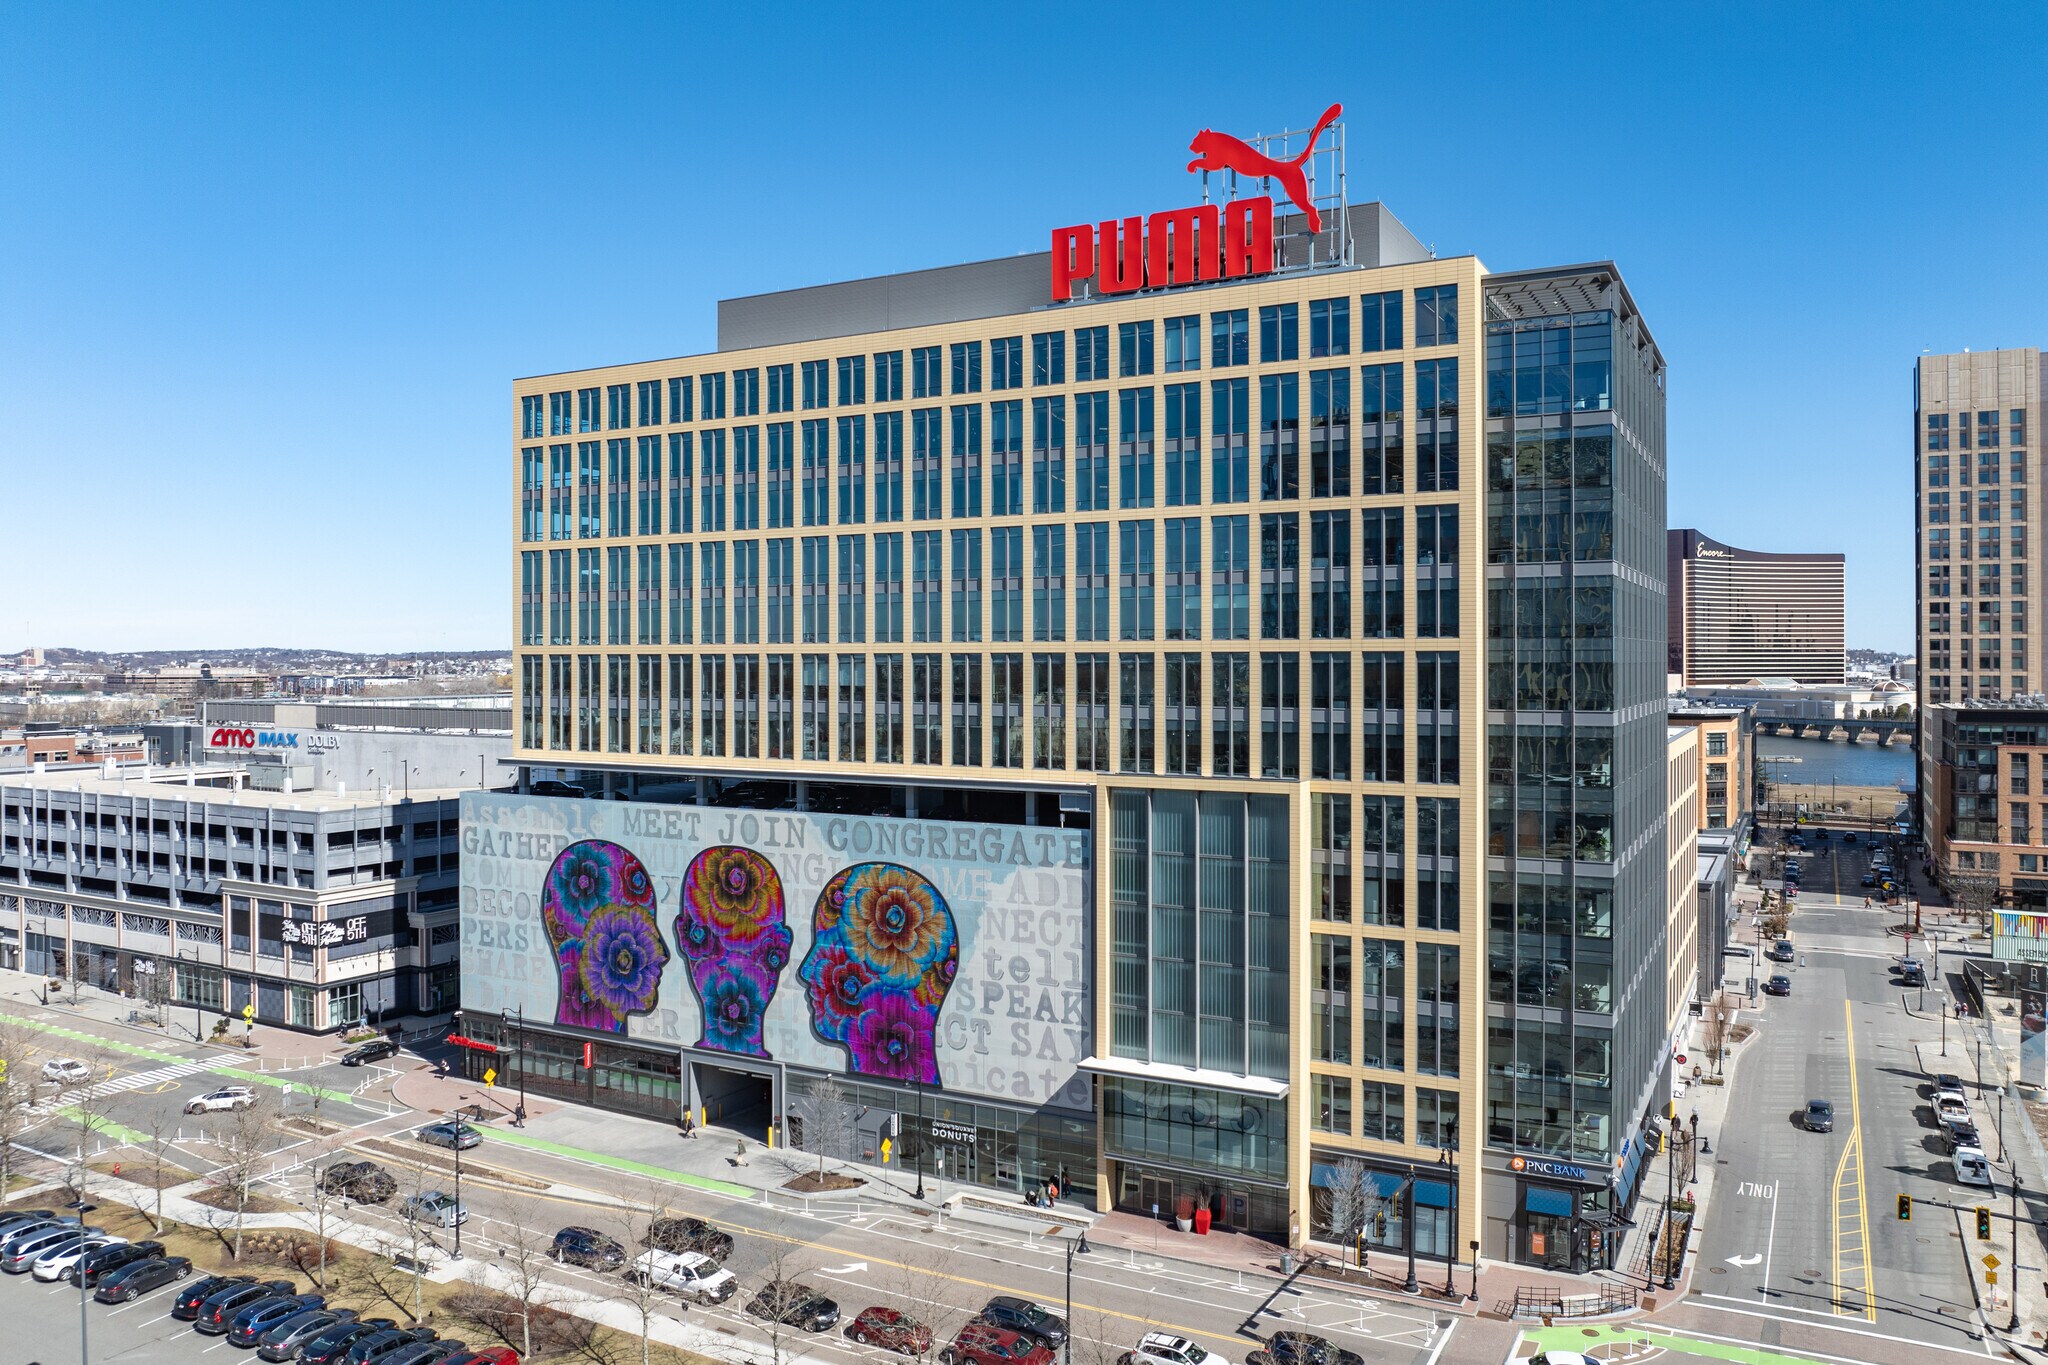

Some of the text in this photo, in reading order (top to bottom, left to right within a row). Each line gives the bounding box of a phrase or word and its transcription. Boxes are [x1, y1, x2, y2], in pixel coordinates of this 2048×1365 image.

[1051, 195, 1275, 301] PUMA
[1696, 541, 1734, 558] Encore
[258, 731, 299, 749] IMAX
[308, 734, 342, 750] DOLBY
[622, 808, 701, 841] MEET
[719, 813, 807, 848] JOIN
[828, 818, 1091, 870] CONGREGATE
[346, 916, 367, 930] OFF
[347, 927, 367, 941] 5TH
[955, 977, 1089, 1027] SPEAK
[1010, 1021, 1090, 1063] SAY
[932, 1127, 976, 1143] DONUTS
[1526, 1160, 1587, 1178] PNC BANK
[1736, 1181, 1773, 1199] ONLY
